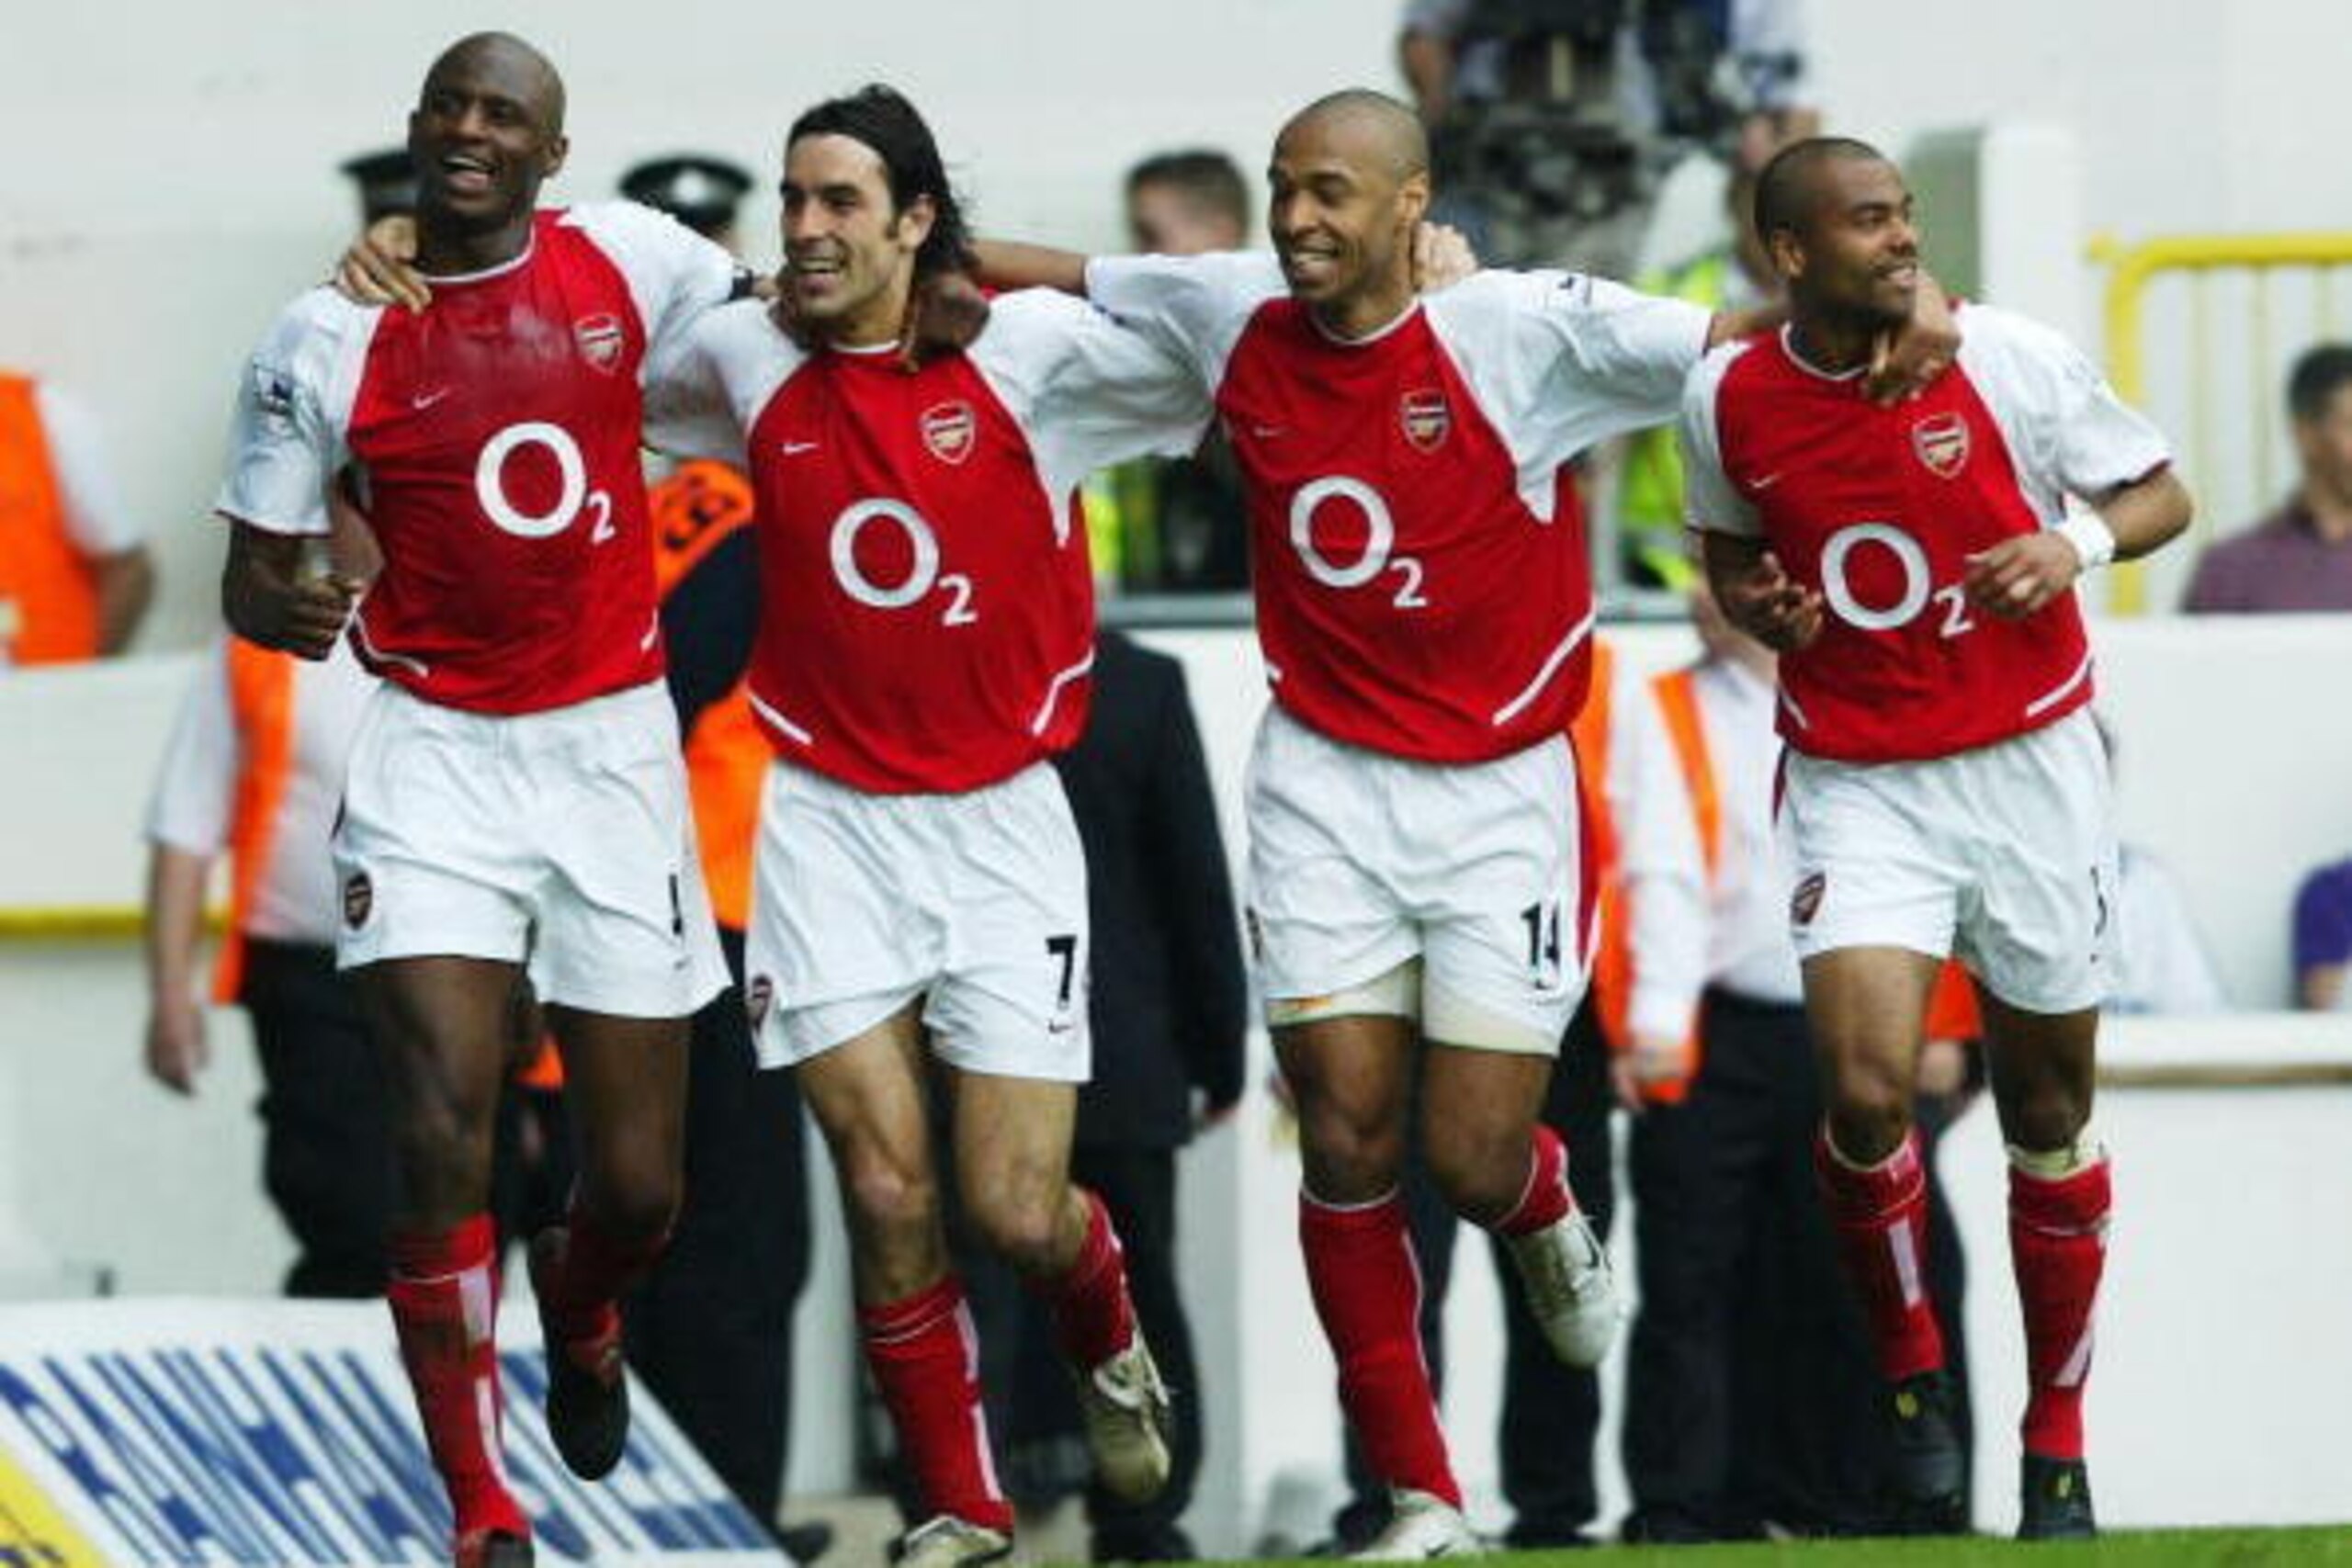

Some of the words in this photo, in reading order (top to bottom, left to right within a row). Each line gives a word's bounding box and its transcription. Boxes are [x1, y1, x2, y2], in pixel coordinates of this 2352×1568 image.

[476, 421, 616, 545] O2
[1289, 474, 1428, 608] O2
[830, 497, 978, 626] O2
[1820, 522, 1974, 637] O2
[1045, 934, 1078, 1010] 7
[1520, 901, 1560, 967] 14
